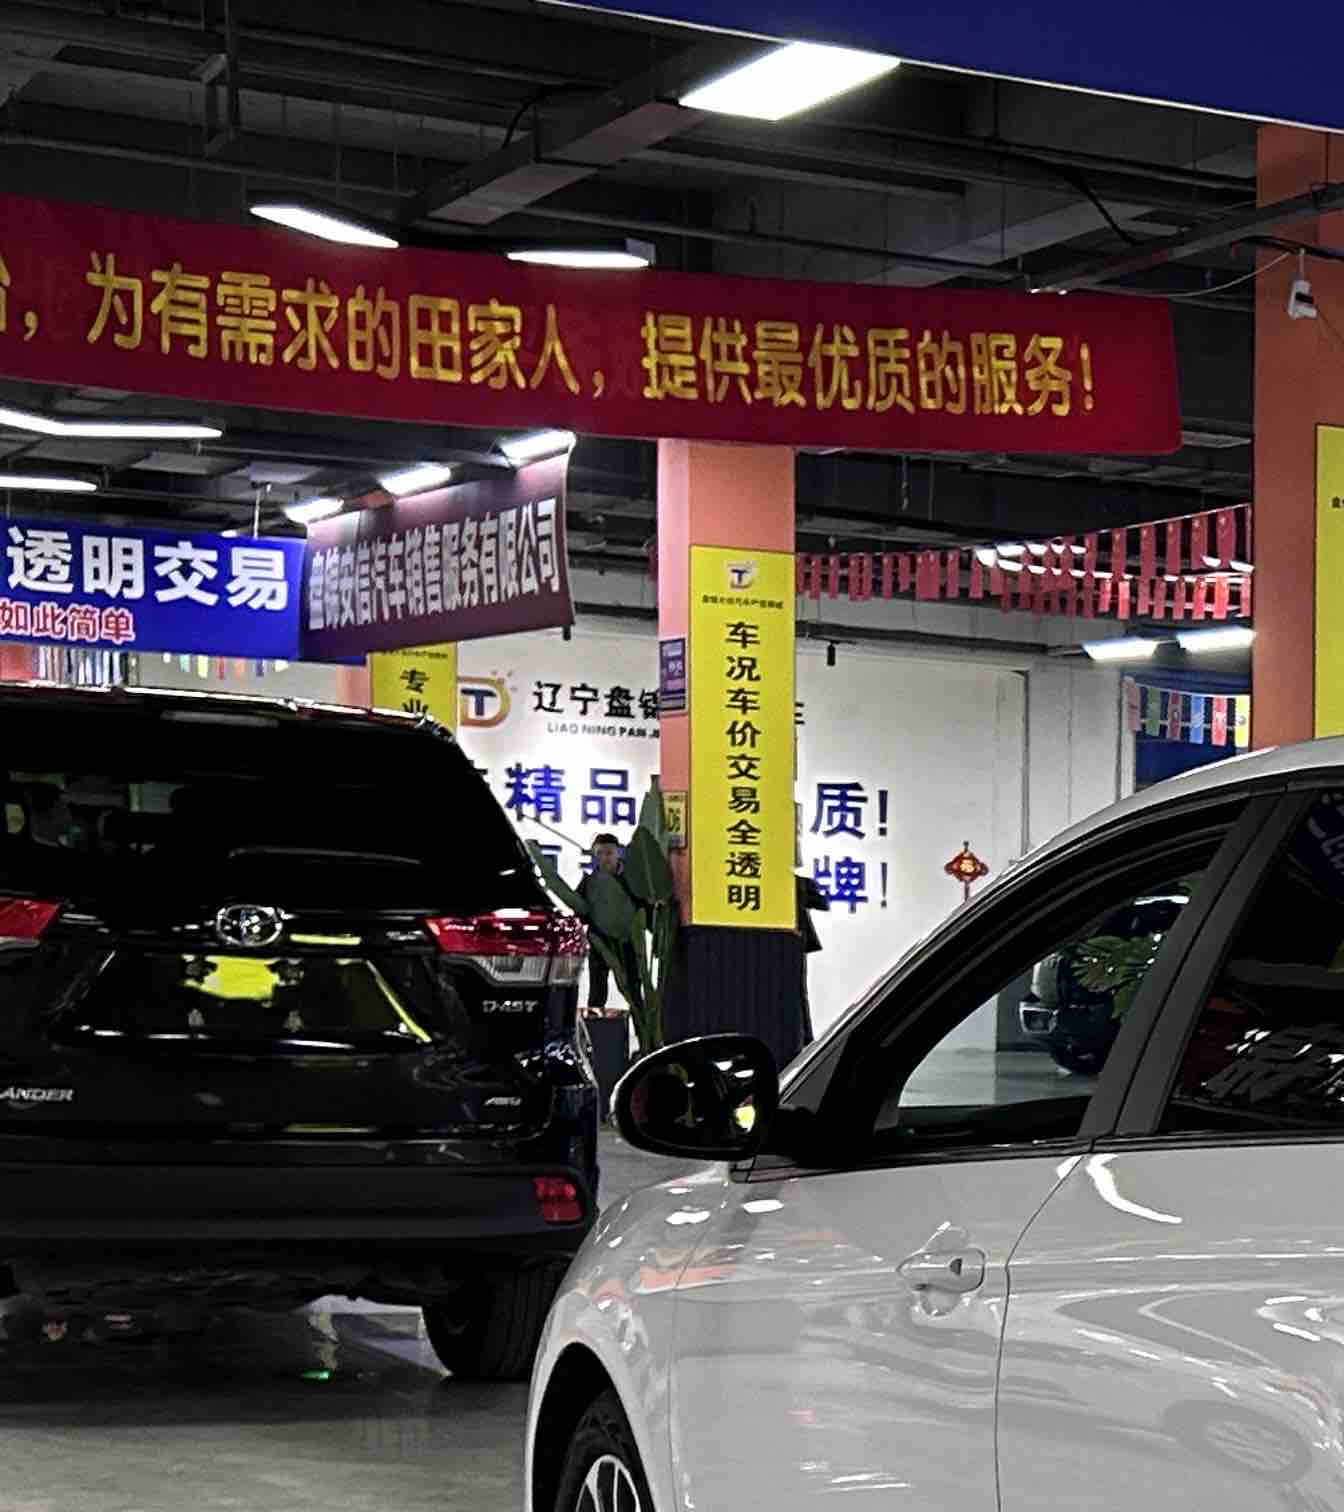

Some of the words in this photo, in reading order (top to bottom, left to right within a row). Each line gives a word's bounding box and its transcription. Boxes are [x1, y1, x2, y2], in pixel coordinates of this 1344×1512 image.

[0, 251, 1095, 418] ，为有需求的田家人，提供最优质的服务！
[7, 525, 289, 610] 透明交易
[0, 601, 135, 644] 如此简单
[505, 763, 637, 825] 精品
[725, 621, 761, 911] 车况车价交易全透明
